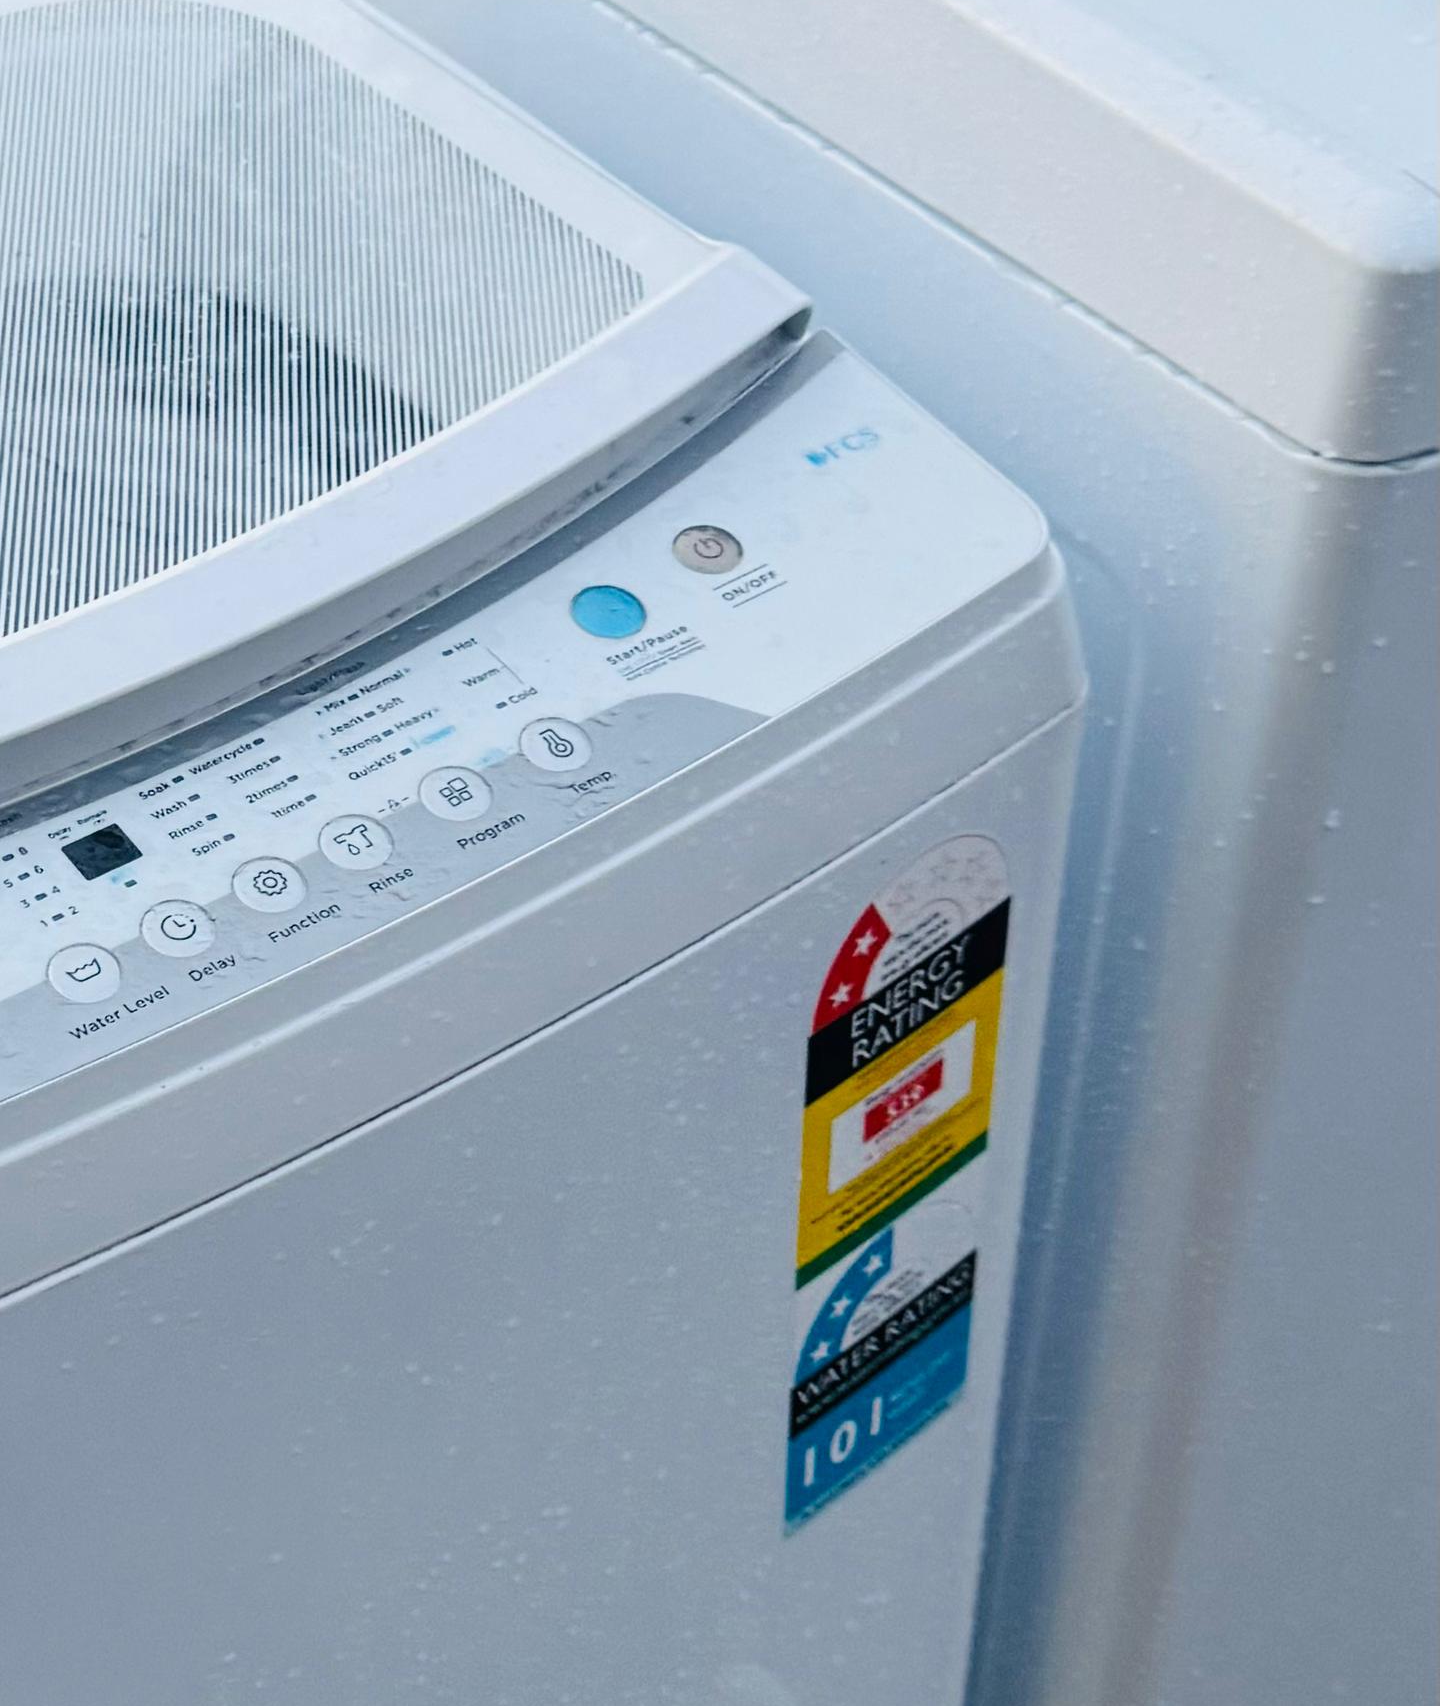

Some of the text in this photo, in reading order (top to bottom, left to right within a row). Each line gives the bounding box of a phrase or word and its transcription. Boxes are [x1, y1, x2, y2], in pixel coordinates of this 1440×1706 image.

[721, 570, 778, 602] ON/OFF
[454, 637, 478, 653] Hot
[606, 625, 689, 666] Start/Pause
[358, 668, 405, 695] Normal
[461, 666, 501, 688] Warm
[376, 695, 405, 714] Soft
[507, 686, 539, 705] Cold
[337, 709, 434, 758] Strong Heavy
[138, 782, 171, 801] Soak
[150, 799, 188, 820] Wash
[168, 779, 289, 841] Rinse 2times
[456, 811, 526, 851] Program
[191, 839, 222, 857] Spin
[3, 864, 45, 890] 5 6
[368, 865, 415, 895] Rinse
[20, 885, 62, 910] 3 4
[68, 905, 80, 916] 2
[267, 900, 343, 946] Function
[187, 953, 238, 984] Delay
[850, 933, 972, 1038] ENERGY
[68, 984, 171, 1042] Water Level
[852, 970, 964, 1068] RATING
[797, 1335, 881, 1405] WATER
[884, 1262, 971, 1343] RATING
[803, 1395, 884, 1488] 101
